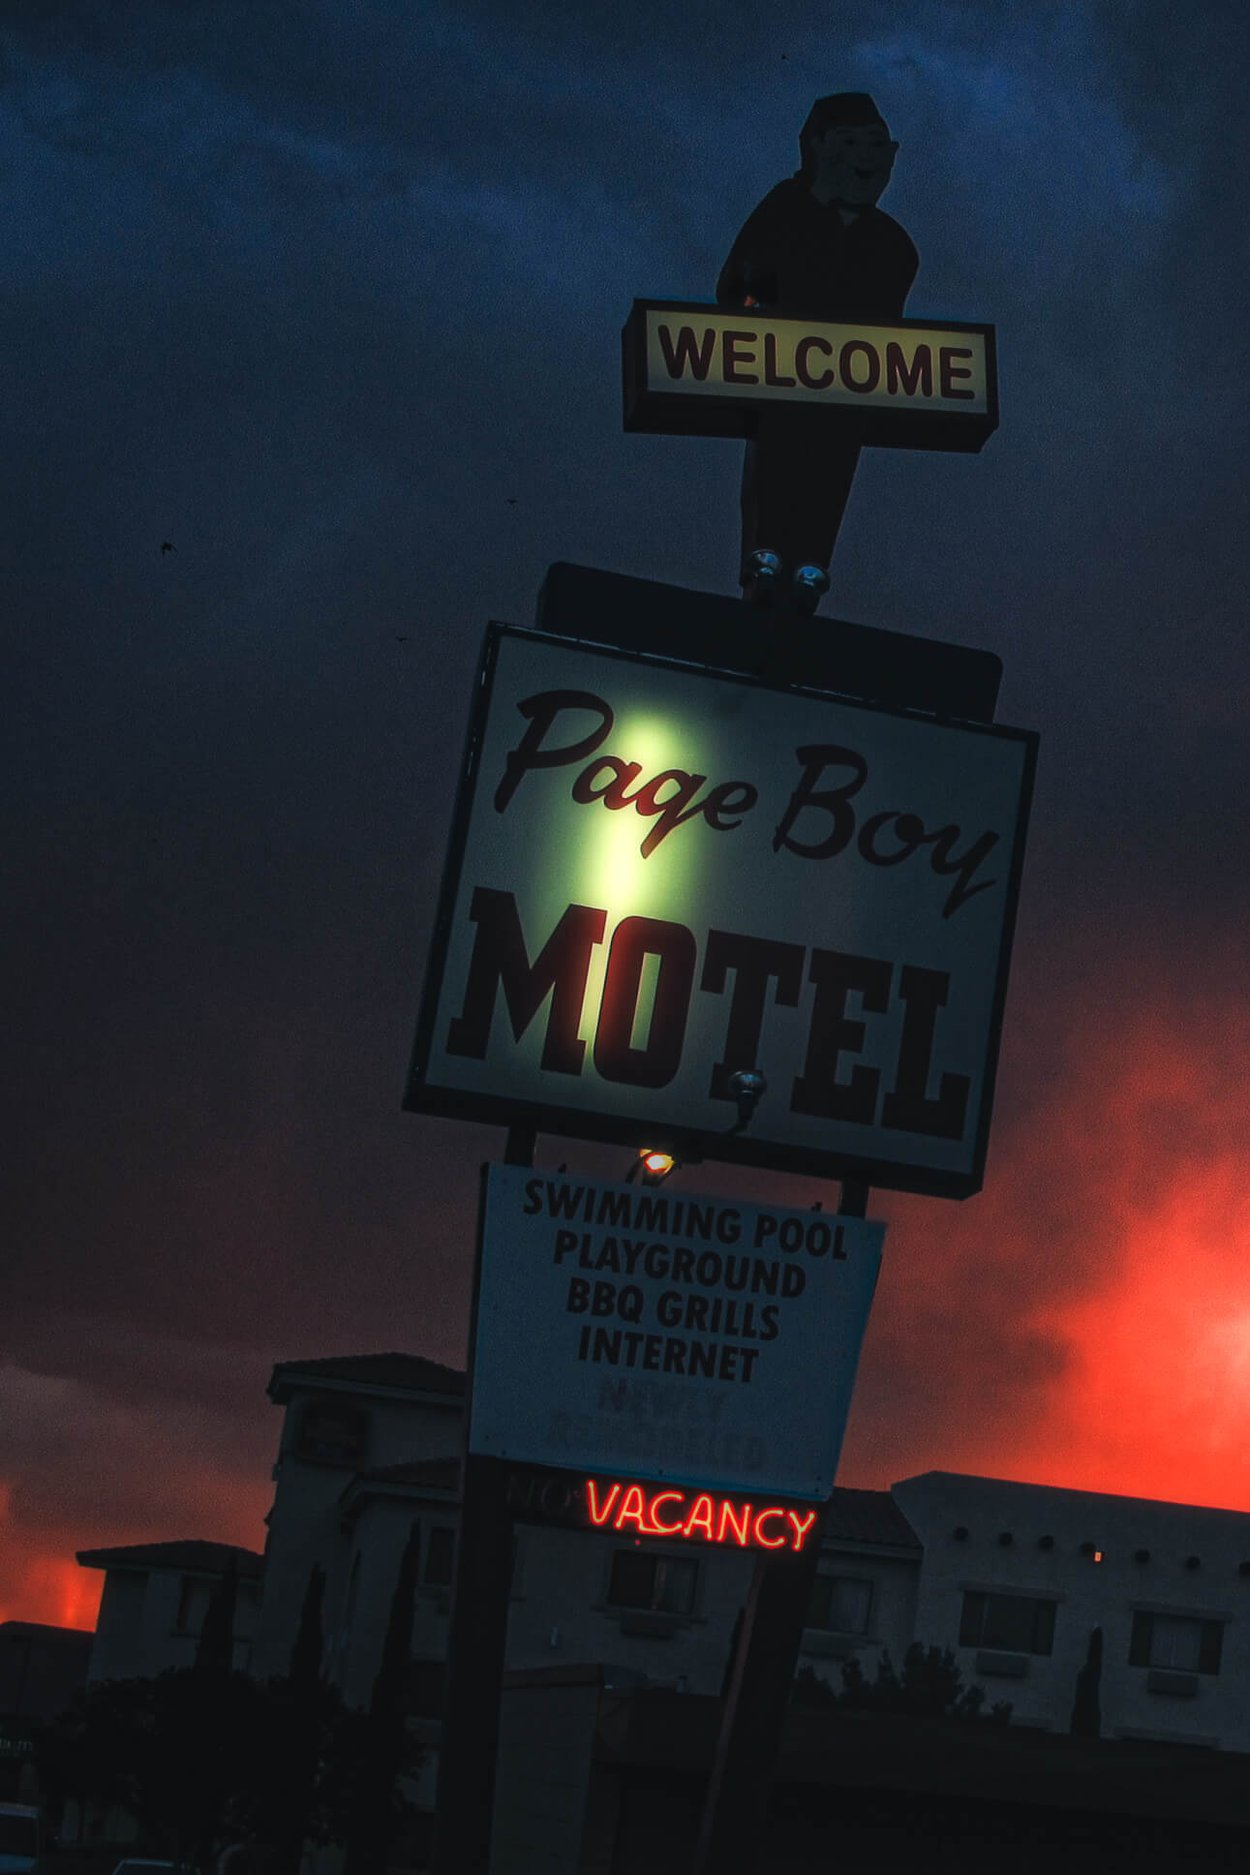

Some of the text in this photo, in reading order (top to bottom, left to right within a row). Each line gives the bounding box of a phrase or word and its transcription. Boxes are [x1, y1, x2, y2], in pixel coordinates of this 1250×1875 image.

[658, 324, 976, 400] WELCOME
[493, 689, 1000, 919] Page Boy
[445, 886, 971, 1141] MOTEL
[523, 1178, 848, 1261] SWIMMING POOL
[552, 1229, 807, 1299] PLAYGROUND
[566, 1277, 780, 1341] BBQ GRILLS
[578, 1325, 760, 1383] INTERNET
[586, 1478, 817, 1553] VACANCY
